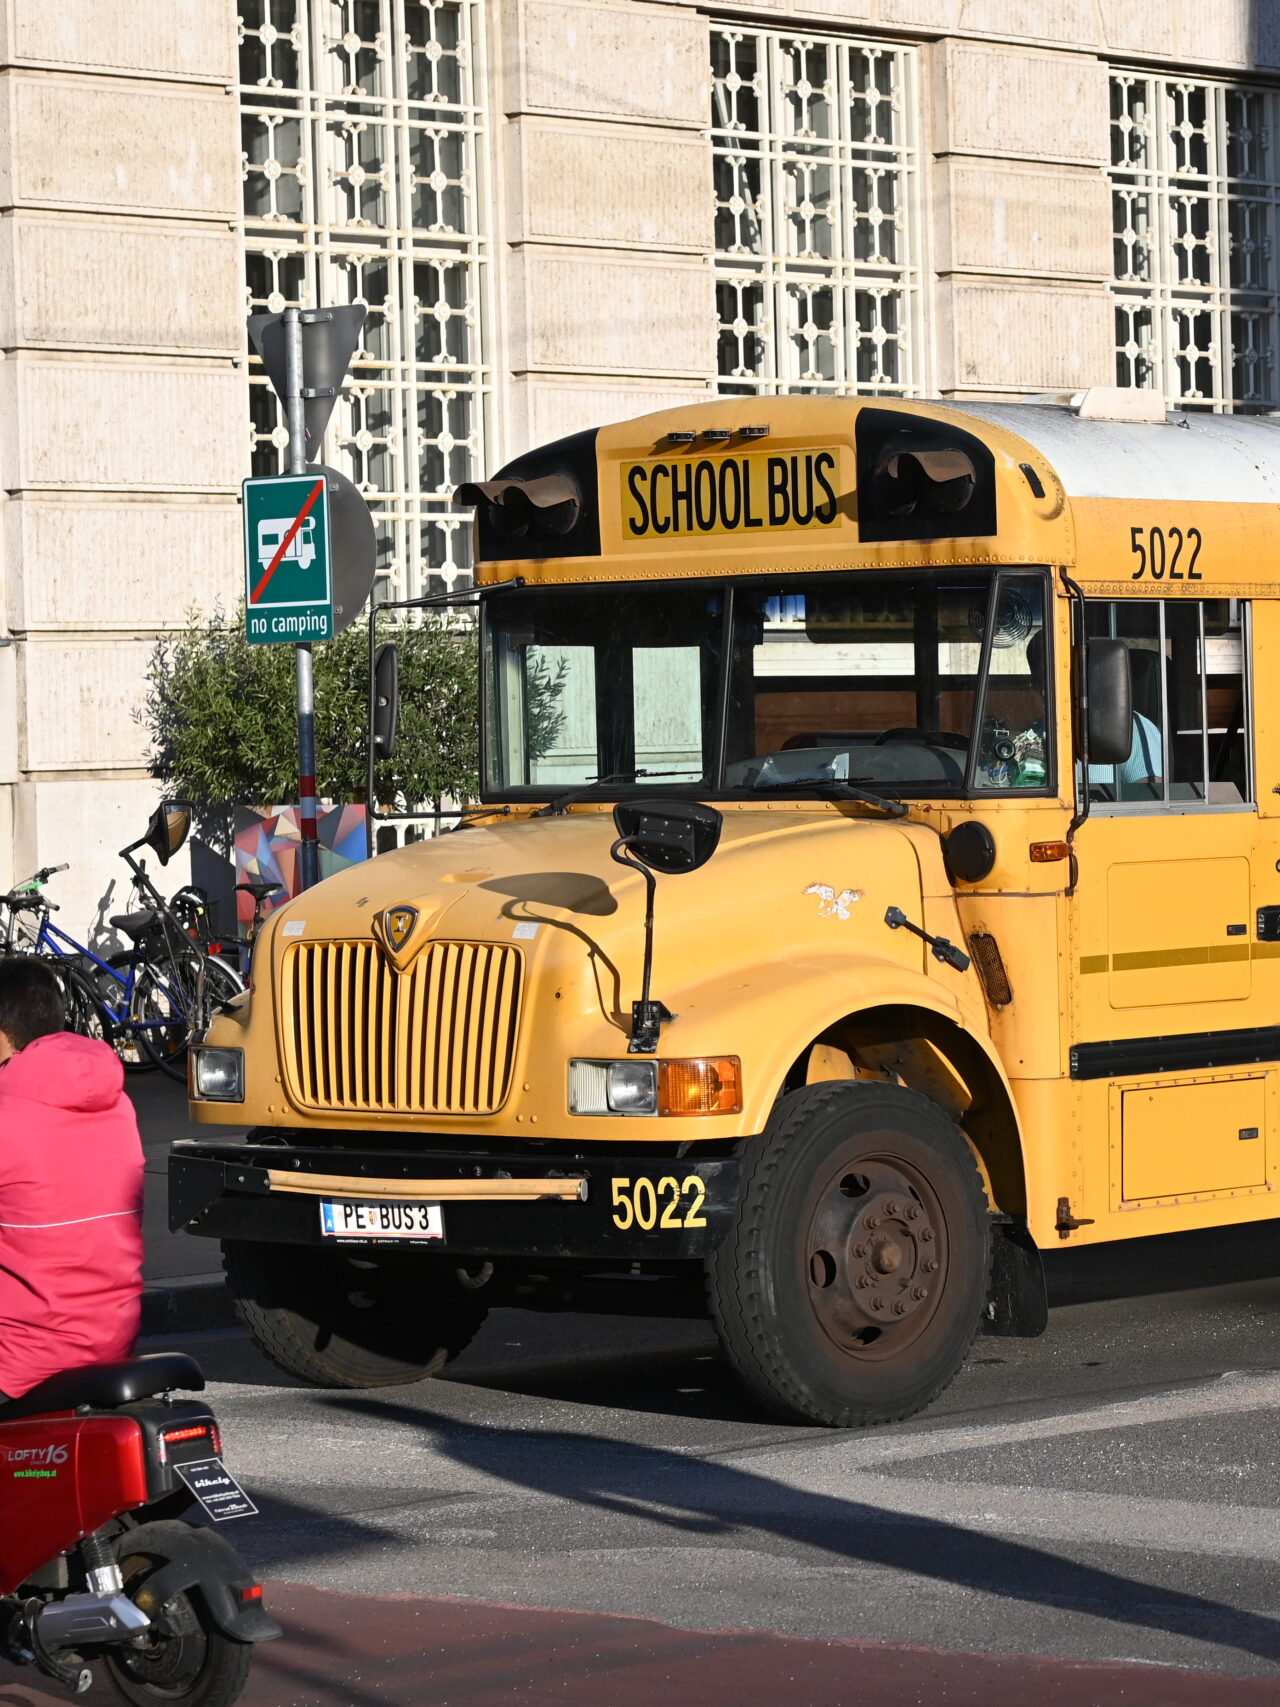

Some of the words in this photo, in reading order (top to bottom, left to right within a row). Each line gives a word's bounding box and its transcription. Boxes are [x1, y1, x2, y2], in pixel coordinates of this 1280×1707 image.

[628, 458, 763, 536] SCHOOL
[768, 452, 837, 527] BUS
[1130, 527, 1202, 580] 5022
[251, 618, 267, 634] no
[271, 610, 328, 636] camping
[343, 1203, 366, 1229] PE
[380, 1203, 414, 1230] BUS
[418, 1204, 429, 1230] 3
[612, 1175, 707, 1230] 5022
